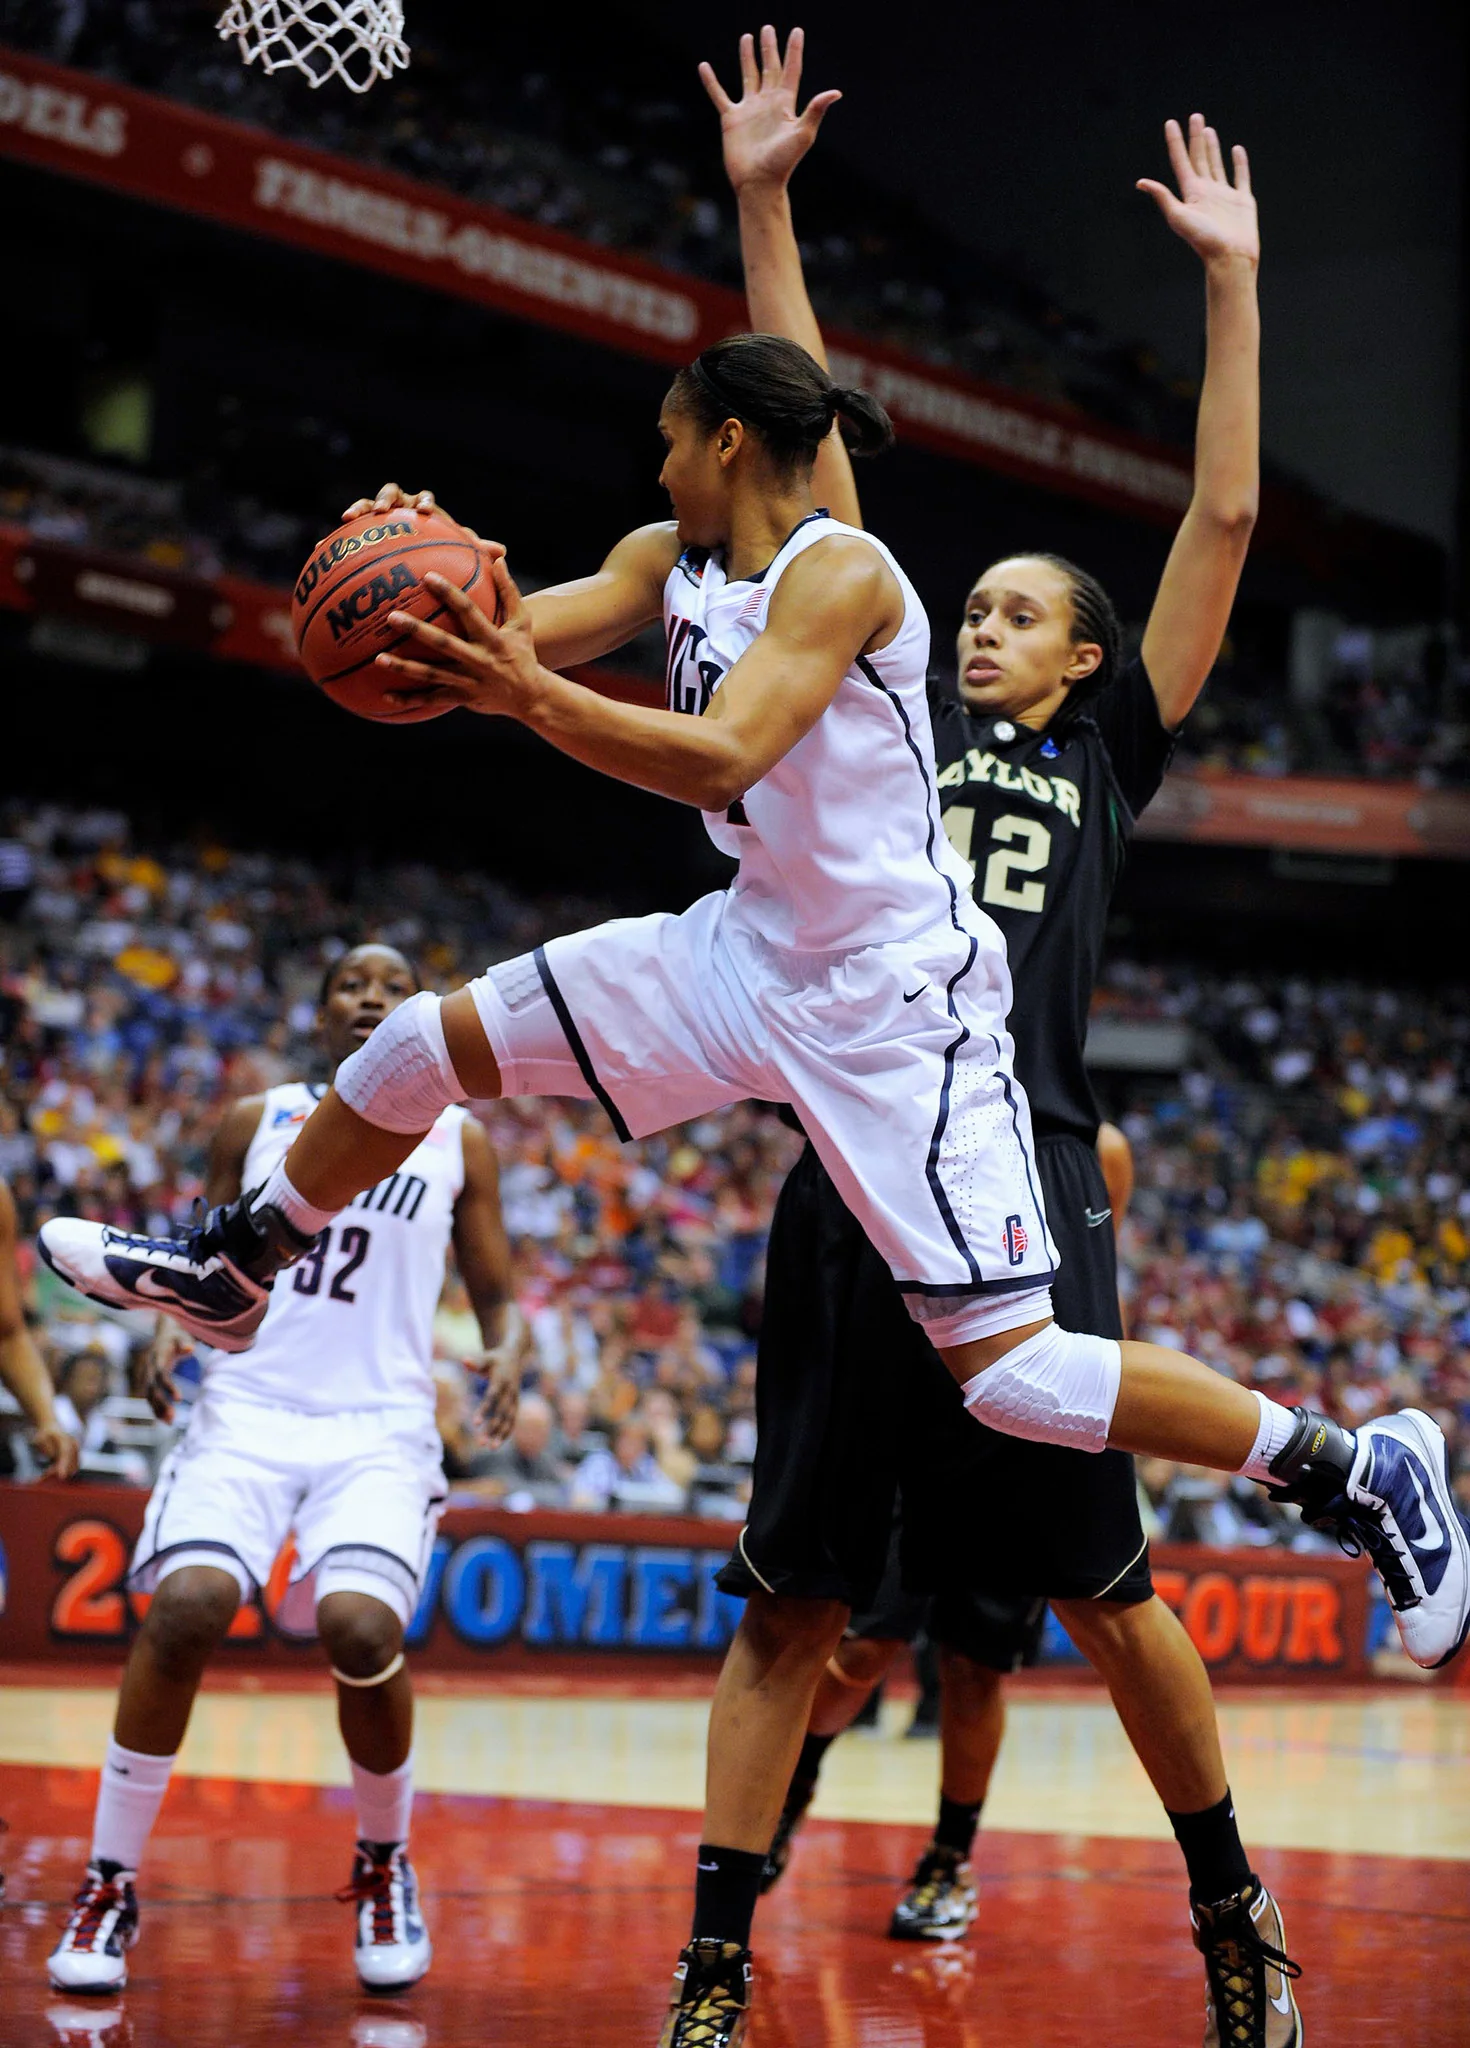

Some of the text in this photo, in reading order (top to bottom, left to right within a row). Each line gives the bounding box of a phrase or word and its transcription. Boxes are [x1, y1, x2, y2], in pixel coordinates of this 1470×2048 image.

[295, 521, 417, 605] Wilson
[326, 562, 420, 640] NCAA
[936, 749, 1081, 828] AYLOR
[395, 1536, 749, 1646] OMEN
